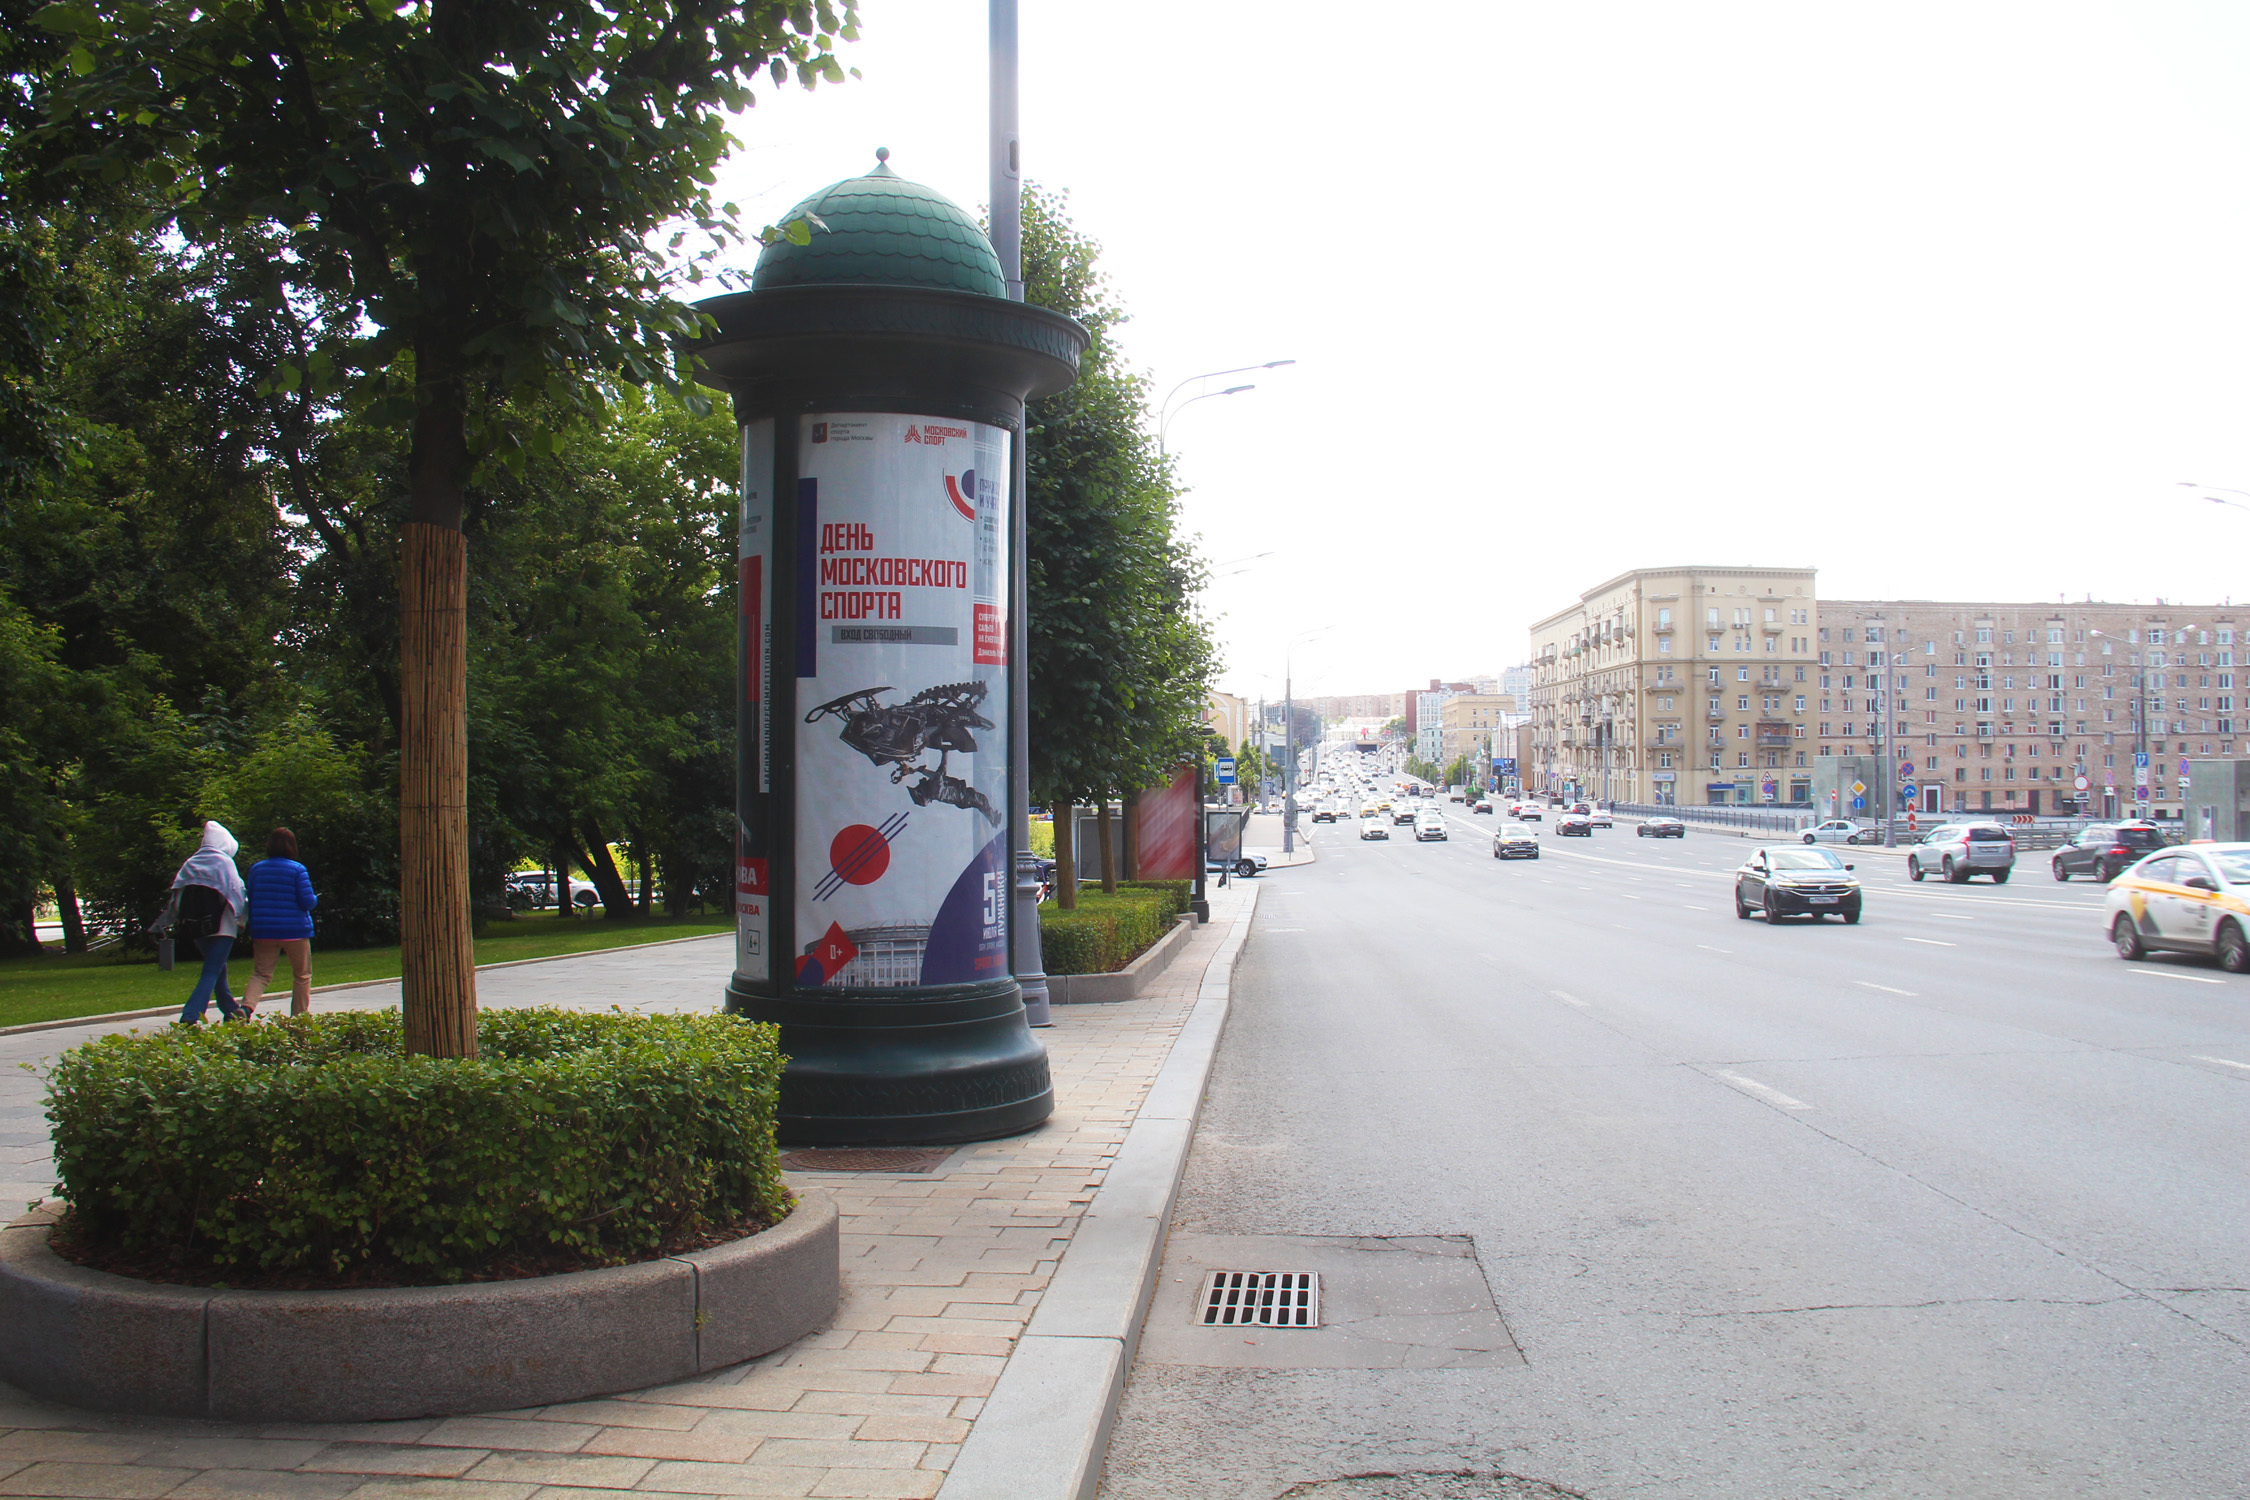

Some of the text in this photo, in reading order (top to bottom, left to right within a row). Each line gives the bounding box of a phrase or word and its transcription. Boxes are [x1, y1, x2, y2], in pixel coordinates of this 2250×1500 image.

[924, 425, 968, 439] МОСКОВСКИЙ
[924, 435, 946, 446] СПОРТ
[820, 523, 873, 554] ДЕНЬ
[820, 558, 967, 589] МОСКОВСКОГО
[820, 592, 901, 620] СПОРТА
[841, 628, 912, 642] ВХОД СВОБОДНЫЙ
[984, 872, 995, 925] 5
[997, 870, 1006, 937] ЛУЖНИКИ
[830, 944, 843, 960] 0+
